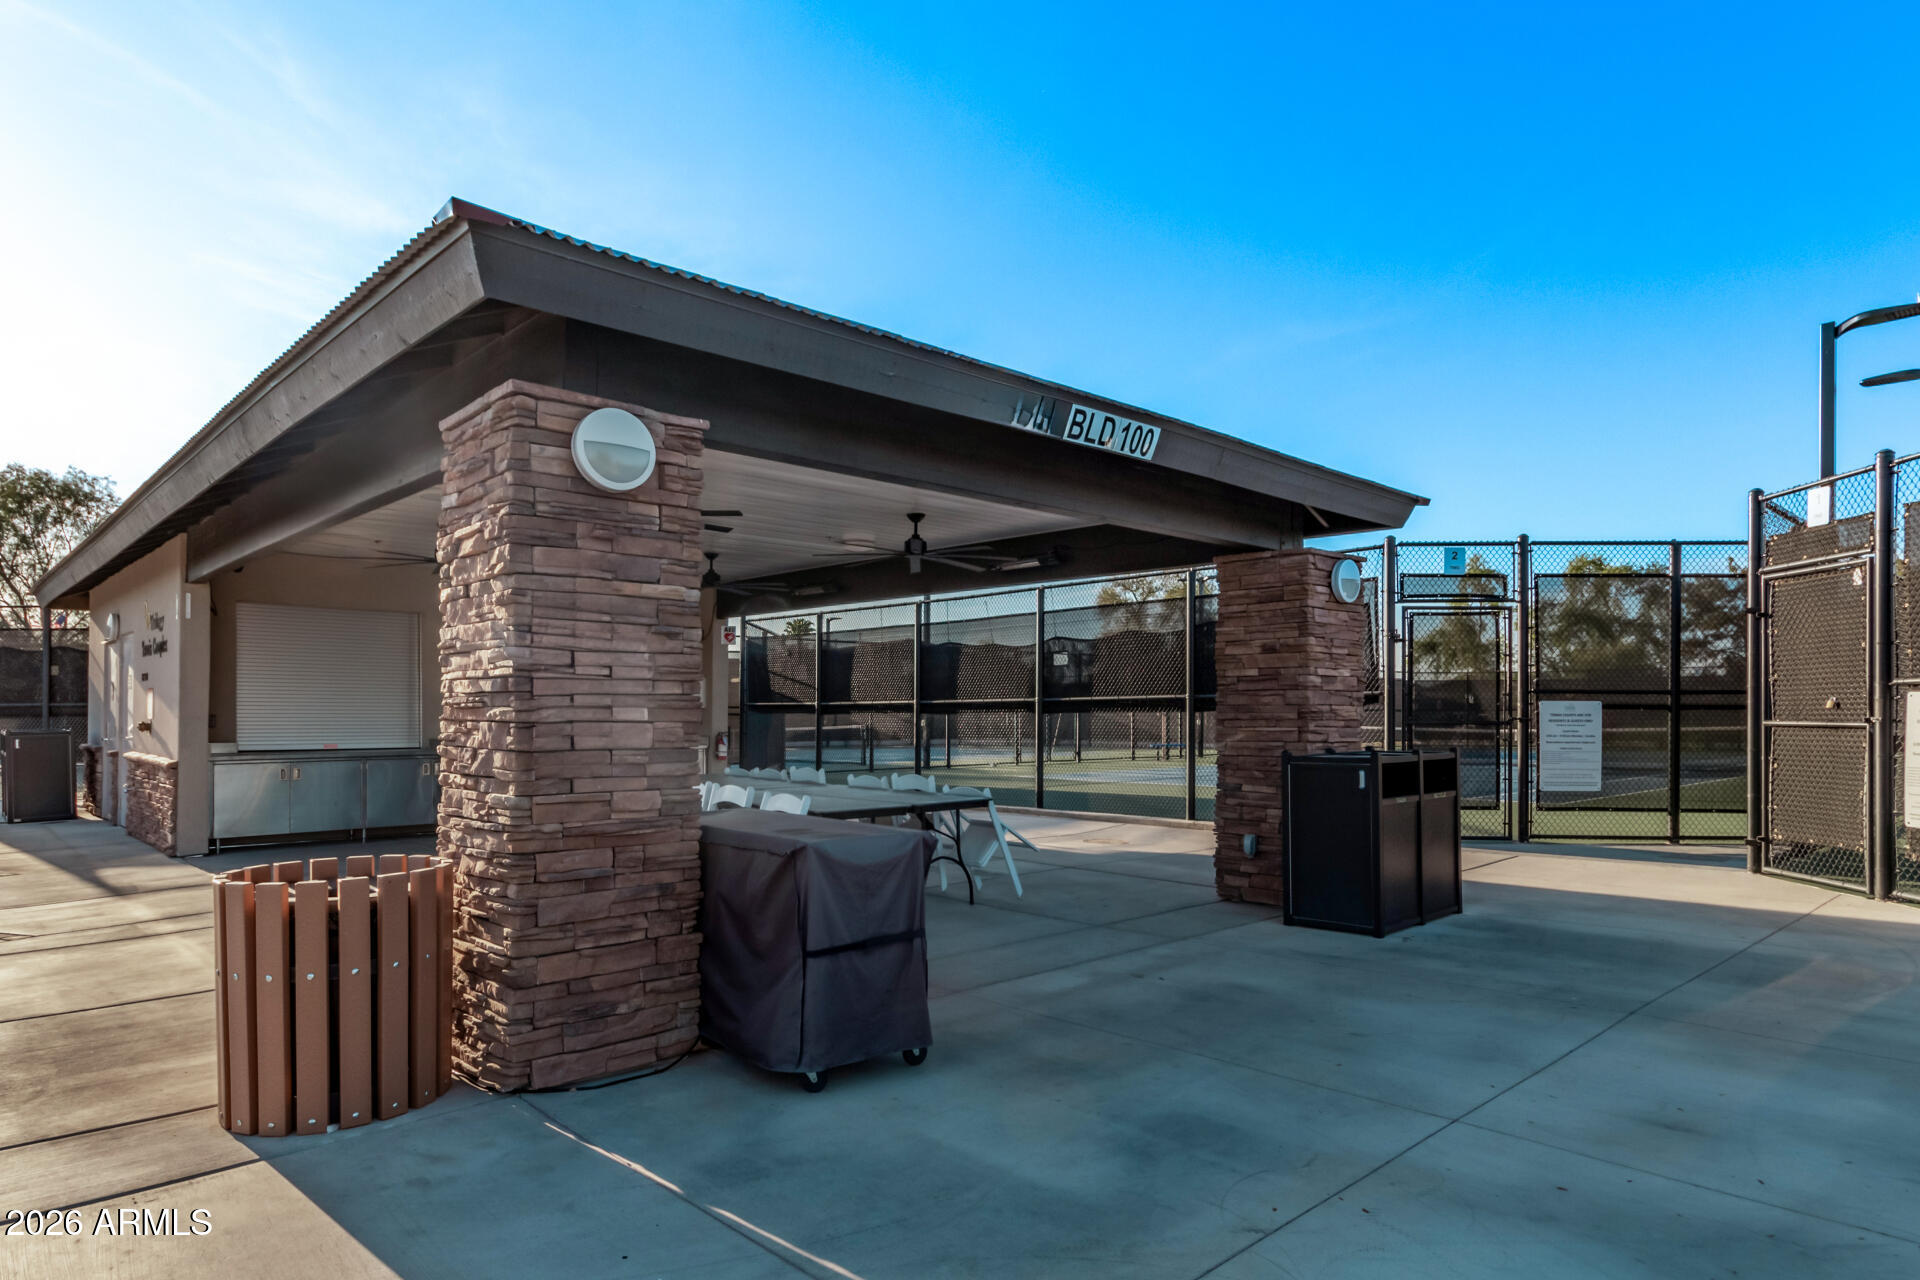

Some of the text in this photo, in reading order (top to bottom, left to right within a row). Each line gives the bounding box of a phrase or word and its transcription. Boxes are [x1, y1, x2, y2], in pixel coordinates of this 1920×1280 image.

[1066, 408, 1154, 456] BLD 100
[1451, 551, 1458, 560] 2
